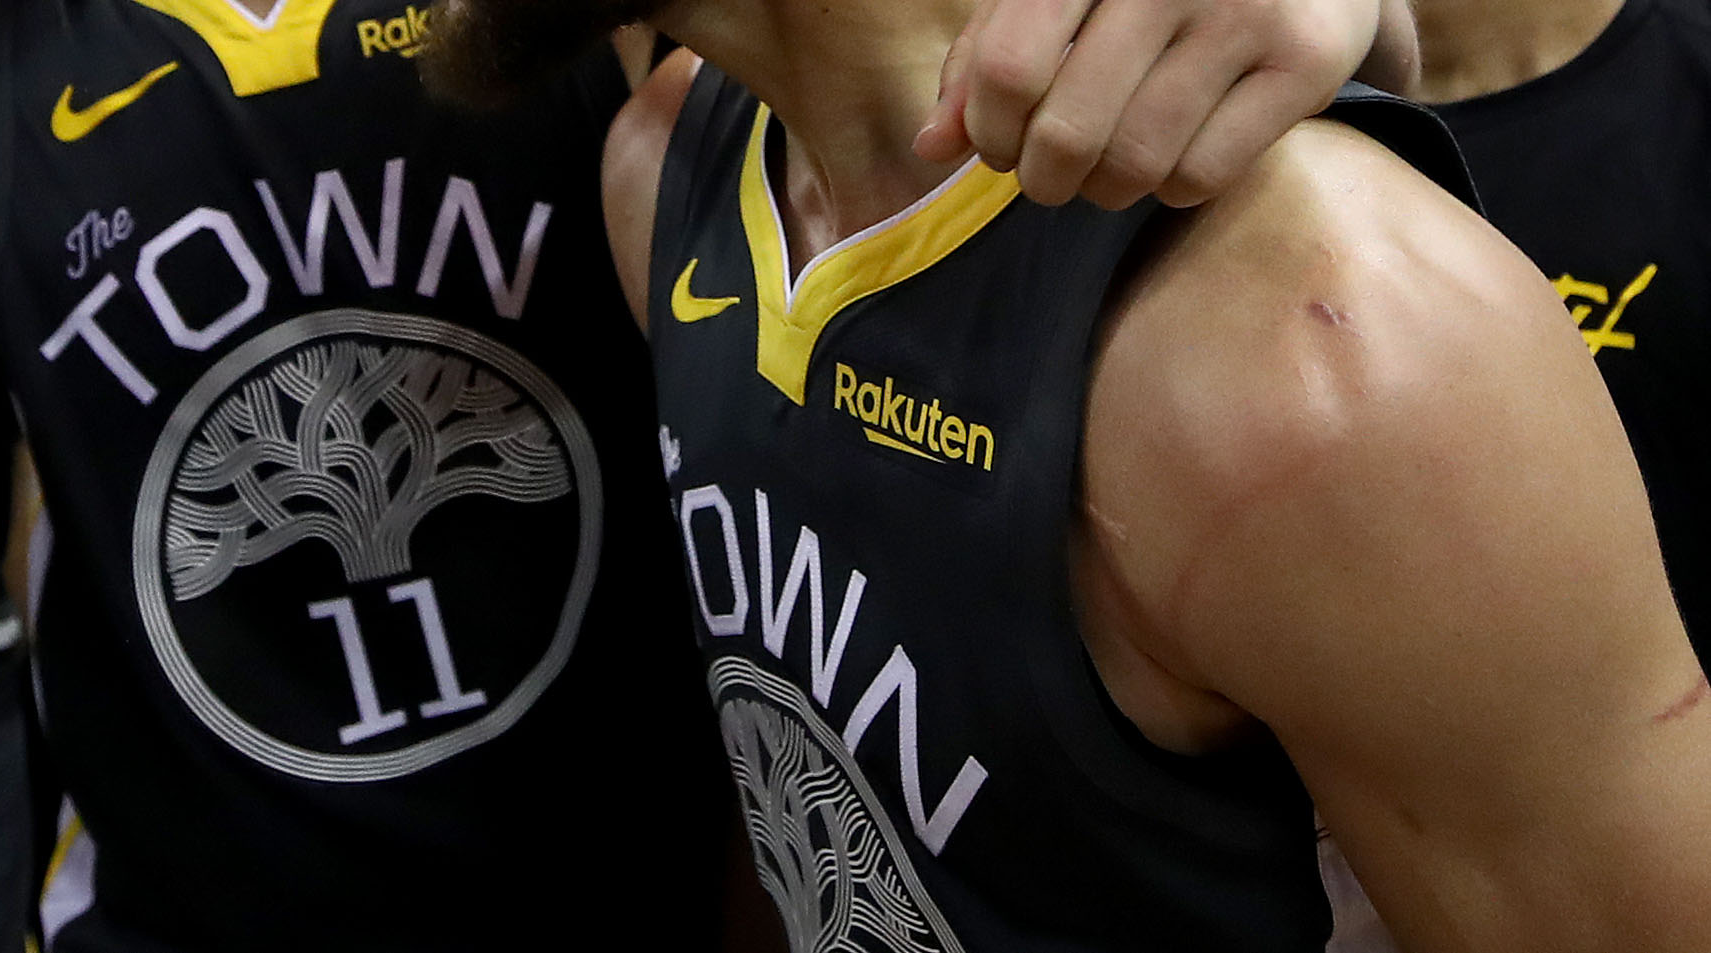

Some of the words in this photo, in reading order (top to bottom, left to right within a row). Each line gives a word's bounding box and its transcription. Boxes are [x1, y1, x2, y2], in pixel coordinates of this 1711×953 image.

[40, 156, 553, 407] TOWN
[65, 206, 135, 280] The
[834, 361, 995, 473] Rakuten
[307, 576, 487, 746] 11
[674, 483, 990, 857] OWN
